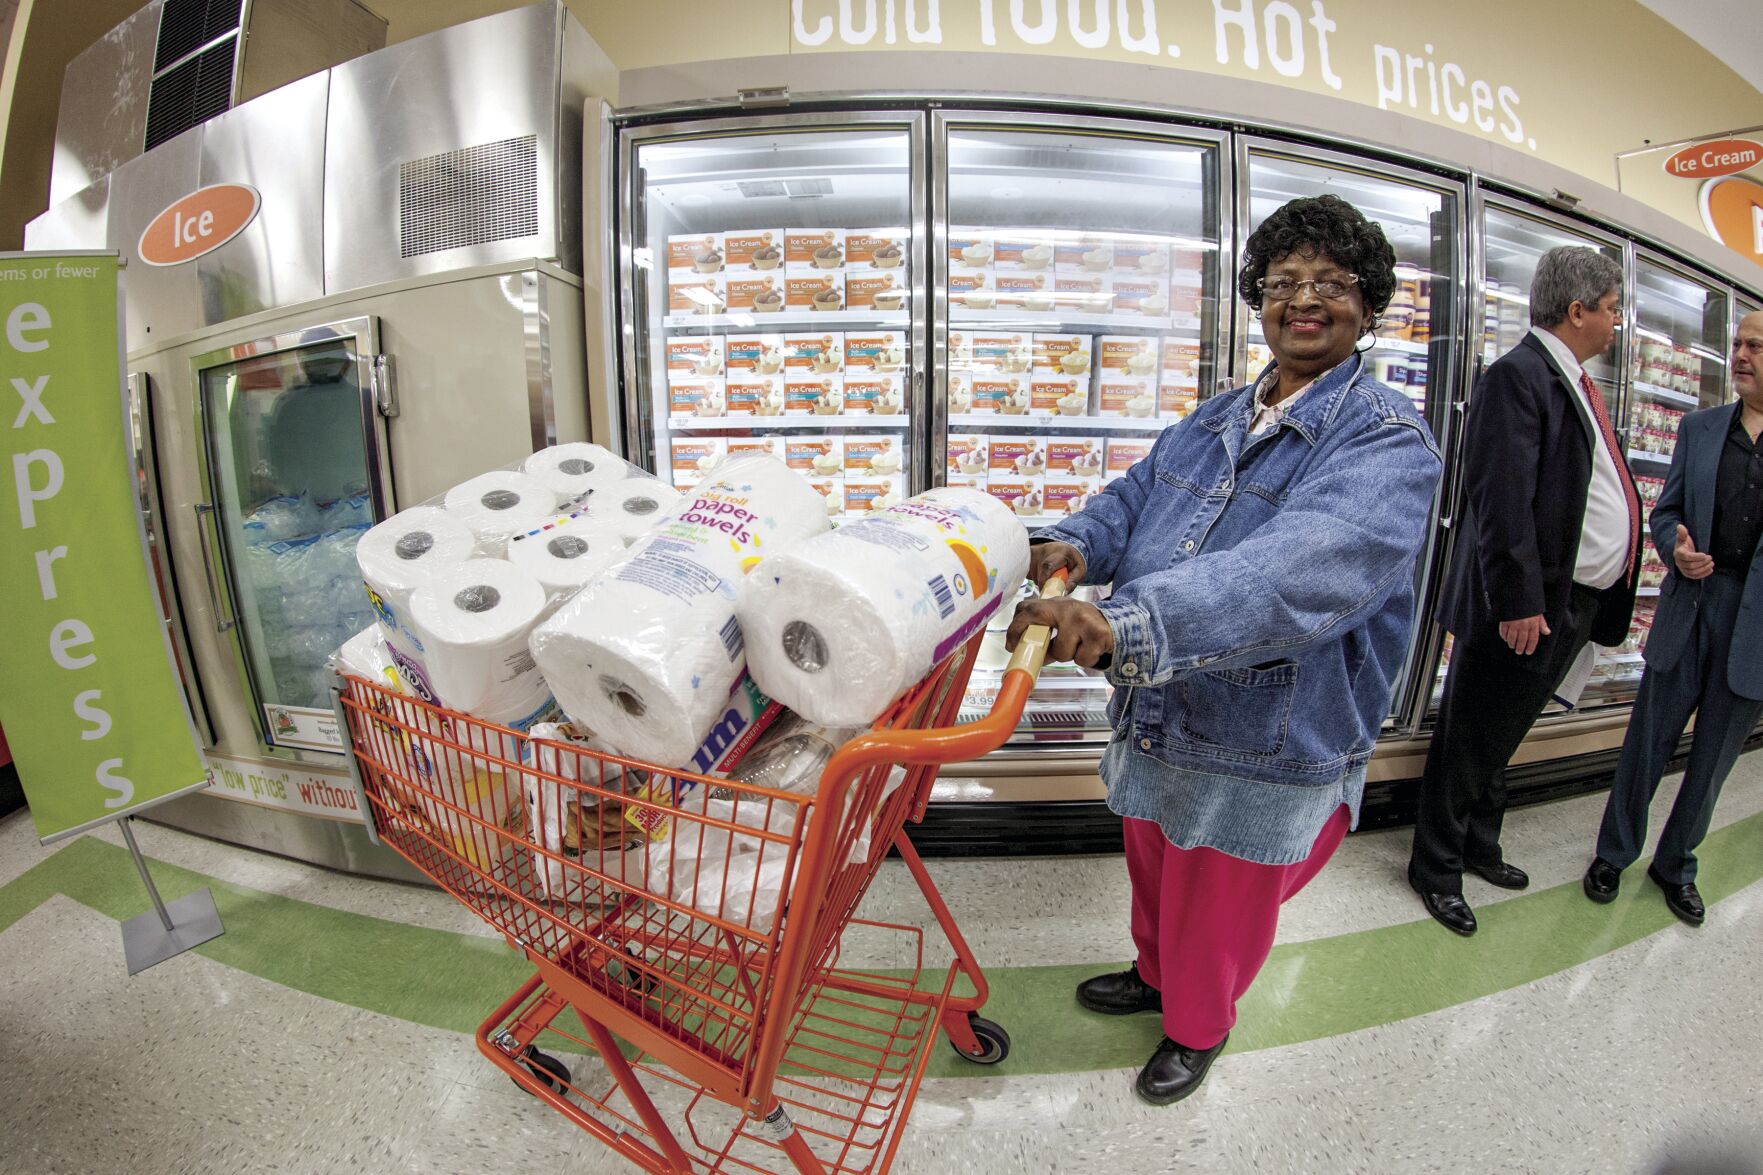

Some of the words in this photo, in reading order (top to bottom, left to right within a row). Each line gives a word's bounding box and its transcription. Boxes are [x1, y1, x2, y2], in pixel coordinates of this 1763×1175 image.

[1212, 0, 1342, 90] Hot
[1374, 44, 1537, 151] prices.
[1675, 157, 1697, 173] Ice
[1701, 149, 1756, 168] Cream
[174, 210, 214, 248] Ice
[32, 268, 51, 280] or
[56, 262, 100, 278] fewer
[690, 499, 758, 524] paper
[679, 513, 751, 544] towels
[6, 302, 135, 808] express
